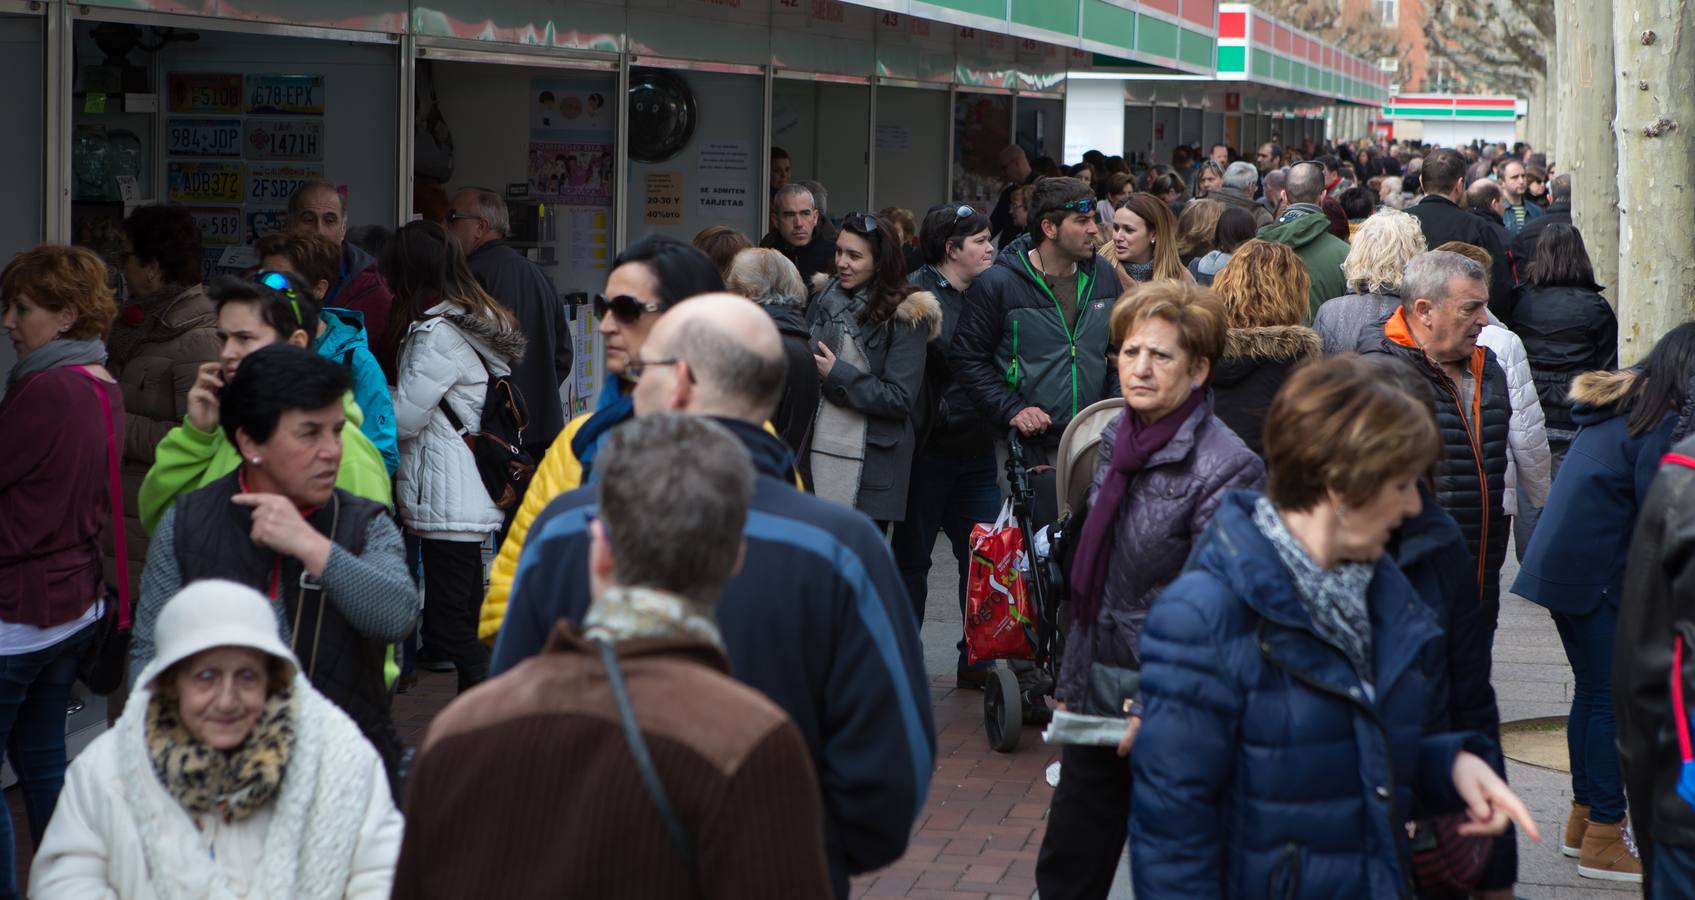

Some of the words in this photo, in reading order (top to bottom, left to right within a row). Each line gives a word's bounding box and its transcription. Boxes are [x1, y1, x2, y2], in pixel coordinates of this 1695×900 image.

[882, 13, 899, 26] 43
[270, 133, 317, 154] 1471H
[713, 187, 745, 195] ADMITEN
[647, 196, 672, 205] 20-30
[674, 196, 680, 205] Y
[700, 198, 744, 207] TARJETAS
